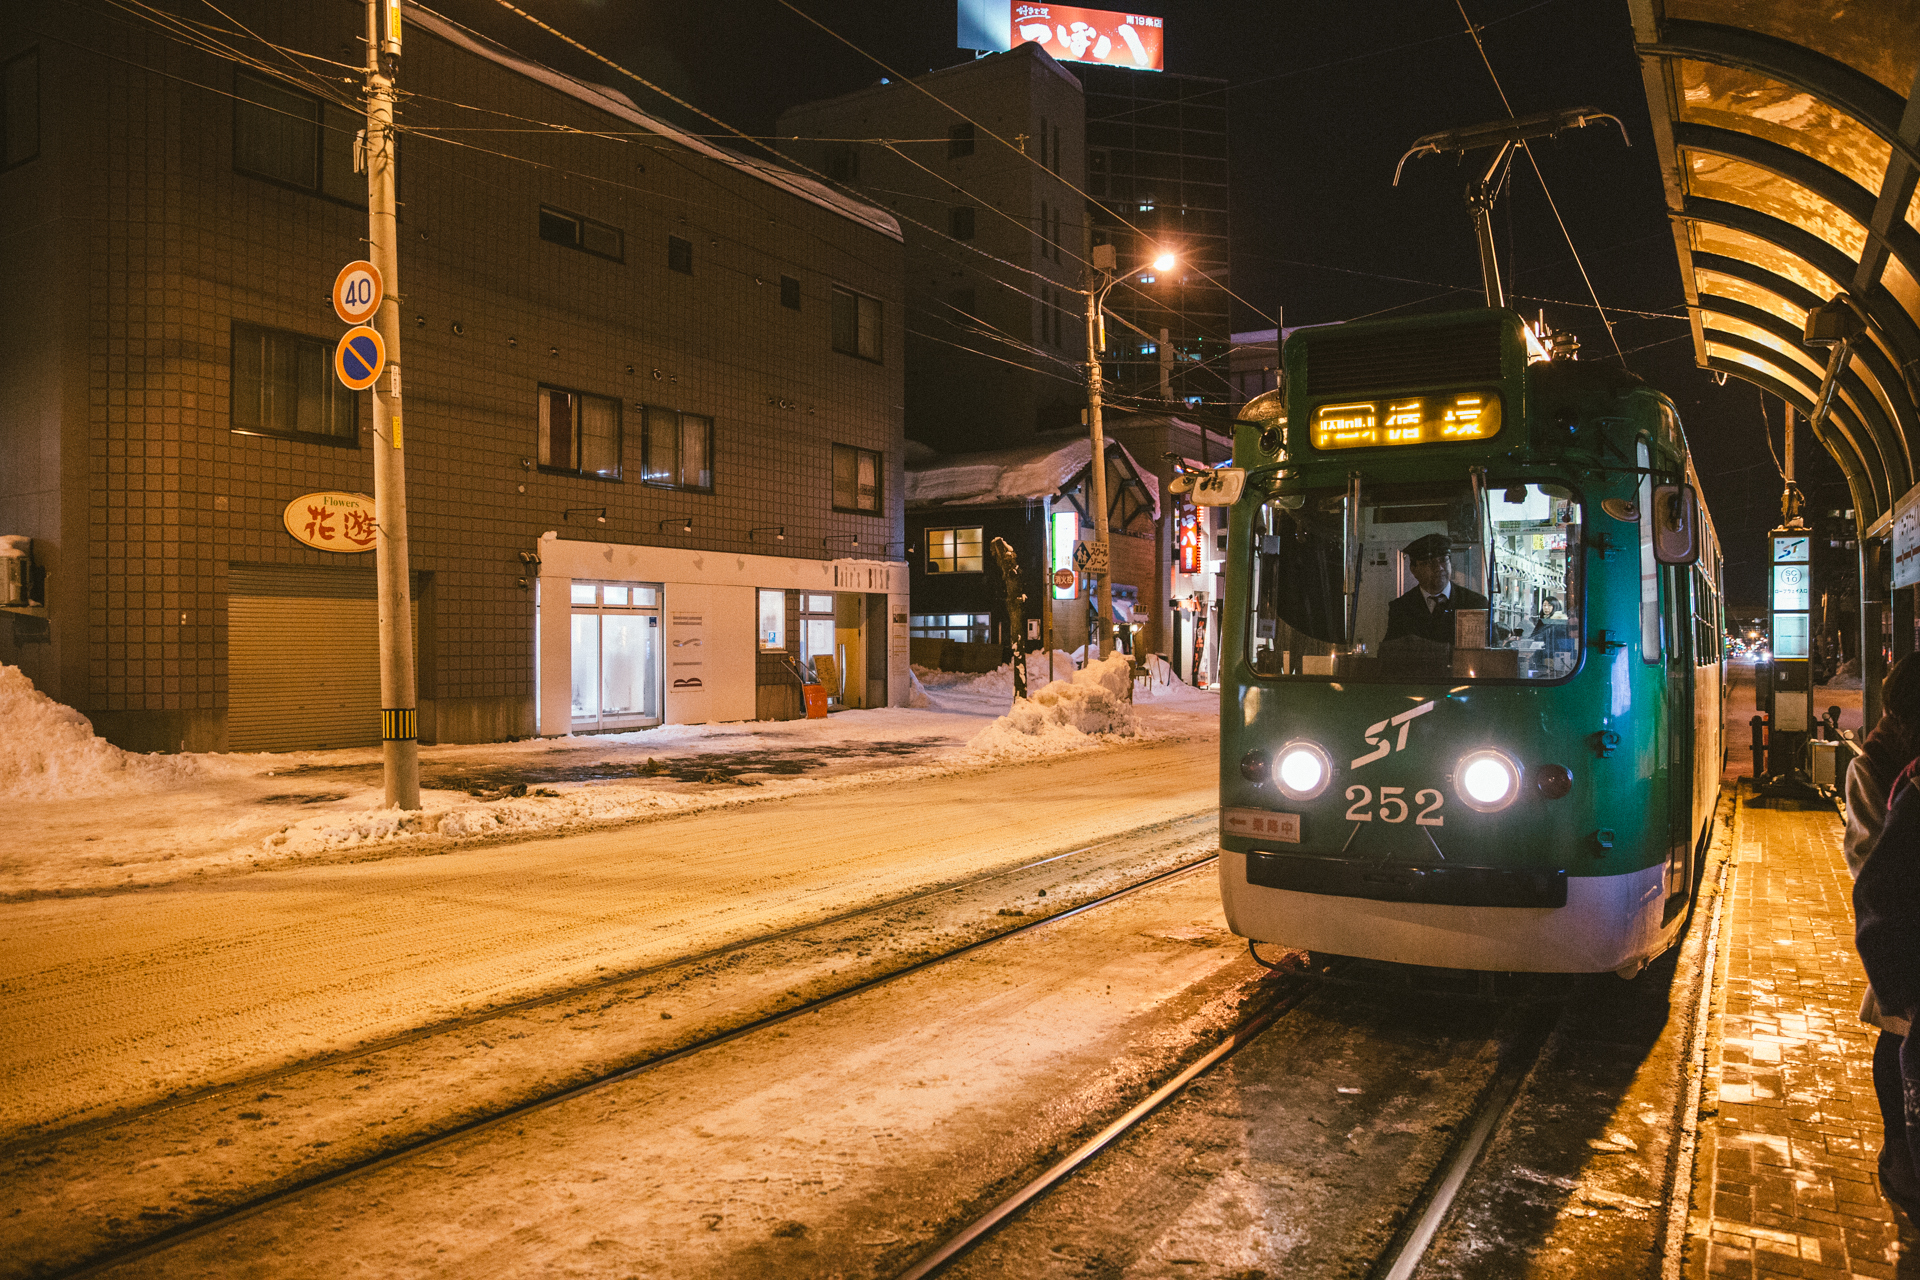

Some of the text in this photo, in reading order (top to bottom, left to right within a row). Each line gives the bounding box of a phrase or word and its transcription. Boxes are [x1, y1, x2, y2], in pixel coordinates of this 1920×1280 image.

[1016, 5, 1049, 16] 好きです
[1126, 15, 1162, 28] 南19条店
[1019, 22, 1149, 66] つぼ八
[345, 278, 371, 307] 40
[323, 496, 360, 508] Flowers
[1091, 547, 1108, 557] スクール
[1091, 558, 1108, 567] ゾーン
[1054, 575, 1073, 585] 消火栓
[1350, 700, 1435, 770] ST
[1345, 785, 1445, 827] 252
[1252, 817, 1293, 835] 乗降中
